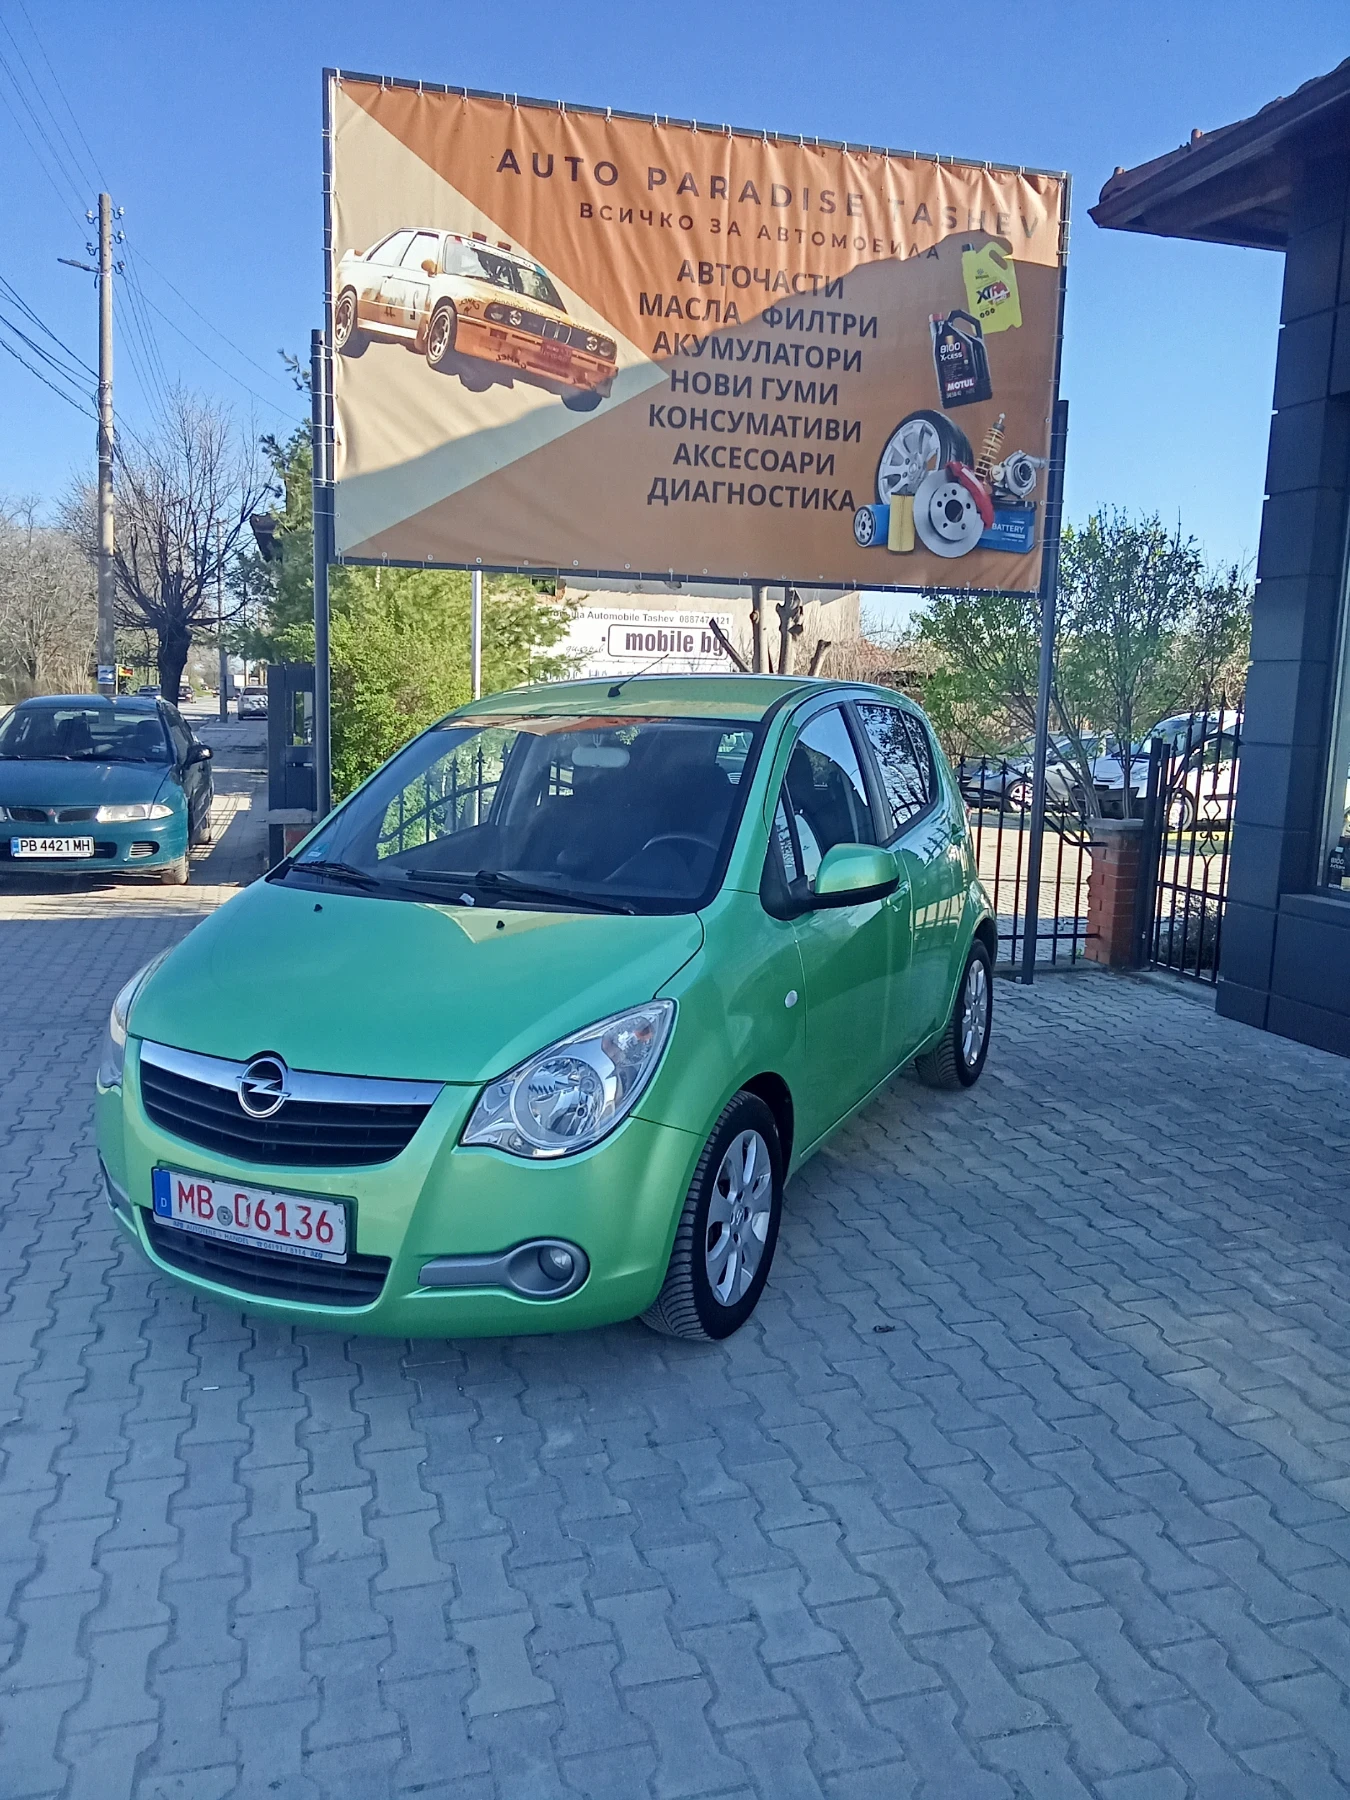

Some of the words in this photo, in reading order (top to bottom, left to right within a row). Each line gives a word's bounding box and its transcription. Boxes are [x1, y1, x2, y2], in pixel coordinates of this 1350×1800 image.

[496, 148, 619, 187] AUTO
[647, 166, 863, 217] PARADISE
[887, 198, 1039, 239] TASHEV
[580, 202, 694, 231] ВСИЧКО
[709, 217, 742, 237] ЗА
[757, 224, 940, 261] АВТОМОБИЛА
[676, 259, 844, 300] АВТОЧАСТИ
[639, 292, 742, 325] МАСЛА
[761, 304, 879, 339] ФИЛТРИ
[652, 330, 863, 373] АКУМУЛАТОРИ
[940, 342, 961, 354] 8100
[670, 369, 752, 399] НОВИ
[761, 377, 839, 406] ГУМИ
[947, 378, 975, 392] MOTUL
[649, 403, 862, 443] КОНСУМАТИВИ
[672, 442, 835, 477] АКСЕСОАРИ
[647, 476, 856, 512] ДИАГНОСТИКА
[992, 522, 1025, 534] BATTERY
[587, 610, 640, 622] Automobile
[643, 613, 675, 624] Tashev
[679, 614, 730, 625] 088747121
[625, 629, 694, 653] mobile
[20, 839, 38, 852] PB
[40, 839, 70, 852] 4421
[73, 839, 90, 852] MH
[160, 1197, 168, 1208] D
[177, 1180, 215, 1221] MB
[234, 1193, 334, 1244] 06136
[224, 1233, 250, 1245] HANDEL
